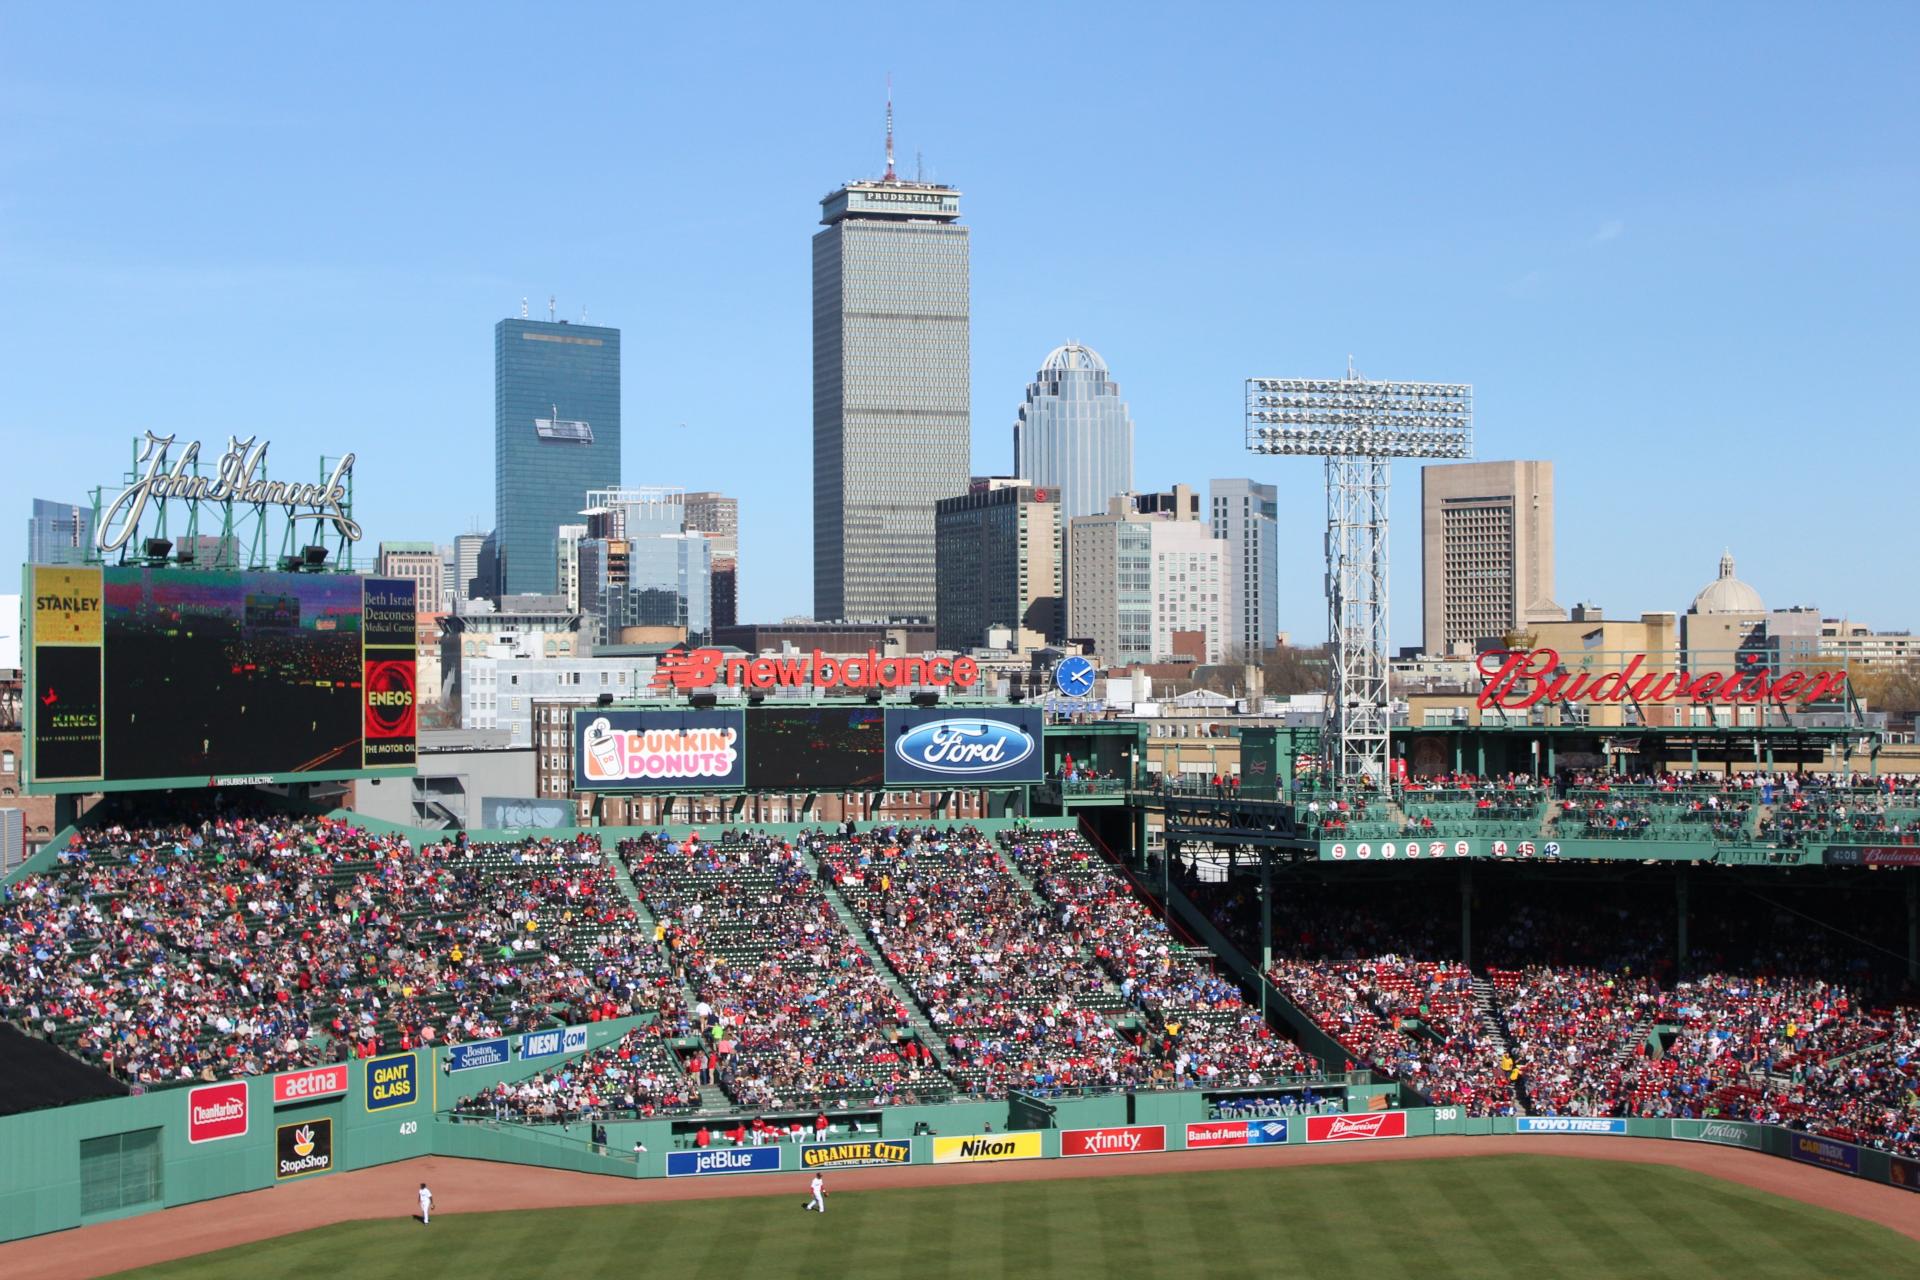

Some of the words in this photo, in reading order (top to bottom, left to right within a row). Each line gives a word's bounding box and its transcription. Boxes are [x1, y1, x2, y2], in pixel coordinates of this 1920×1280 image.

[867, 192, 940, 202] PRUDENTIAL
[97, 430, 208, 552] John
[208, 435, 362, 541] Hancock
[37, 596, 98, 612] STANLEY
[365, 592, 386, 605] Beth
[389, 592, 415, 606] Israel
[365, 607, 415, 621] Deaconess
[365, 622, 392, 632] Medical
[393, 623, 415, 633] Center
[727, 657, 809, 687] new
[812, 648, 978, 687] balance
[1475, 648, 1847, 709] Budweiser
[368, 692, 412, 706] ENEOS
[365, 745, 378, 754] THE
[379, 744, 403, 753] MOTOR
[404, 744, 415, 752] OIL
[628, 731, 733, 753] DUNKIN'
[924, 727, 1006, 762] Ford
[628, 753, 728, 774] DONUTS
[248, 776, 274, 785] ELECTRIC
[1334, 846, 1343, 857] 9
[1359, 846, 1367, 857] 4
[1409, 845, 1417, 856] 8
[1429, 844, 1447, 856] 27
[1458, 843, 1466, 855] 6
[1491, 843, 1506, 855] 14
[1516, 843, 1534, 855] 45
[1544, 844, 1558, 855] 42
[461, 1050, 501, 1067] Scientific
[467, 1045, 492, 1057] Boston
[374, 1064, 408, 1083] GIANT
[286, 1073, 337, 1096] aetna
[373, 1080, 410, 1100] GLASS
[1435, 1109, 1457, 1120] 380
[400, 1121, 417, 1135] 420
[1332, 1121, 1379, 1132] Budweiser
[1529, 1119, 1569, 1130] TOYO
[1569, 1119, 1611, 1131] TIRES
[1700, 1122, 1748, 1140] Jordan's
[1084, 1131, 1139, 1152] xfinity
[1189, 1130, 1211, 1141] Bank
[1222, 1127, 1259, 1139] America
[804, 1144, 871, 1165] GRANITE
[874, 1142, 908, 1161] CITY
[960, 1140, 1015, 1157] Nikon
[696, 1151, 752, 1173] jetBlue
[824, 1159, 859, 1167] ELECTRIC
